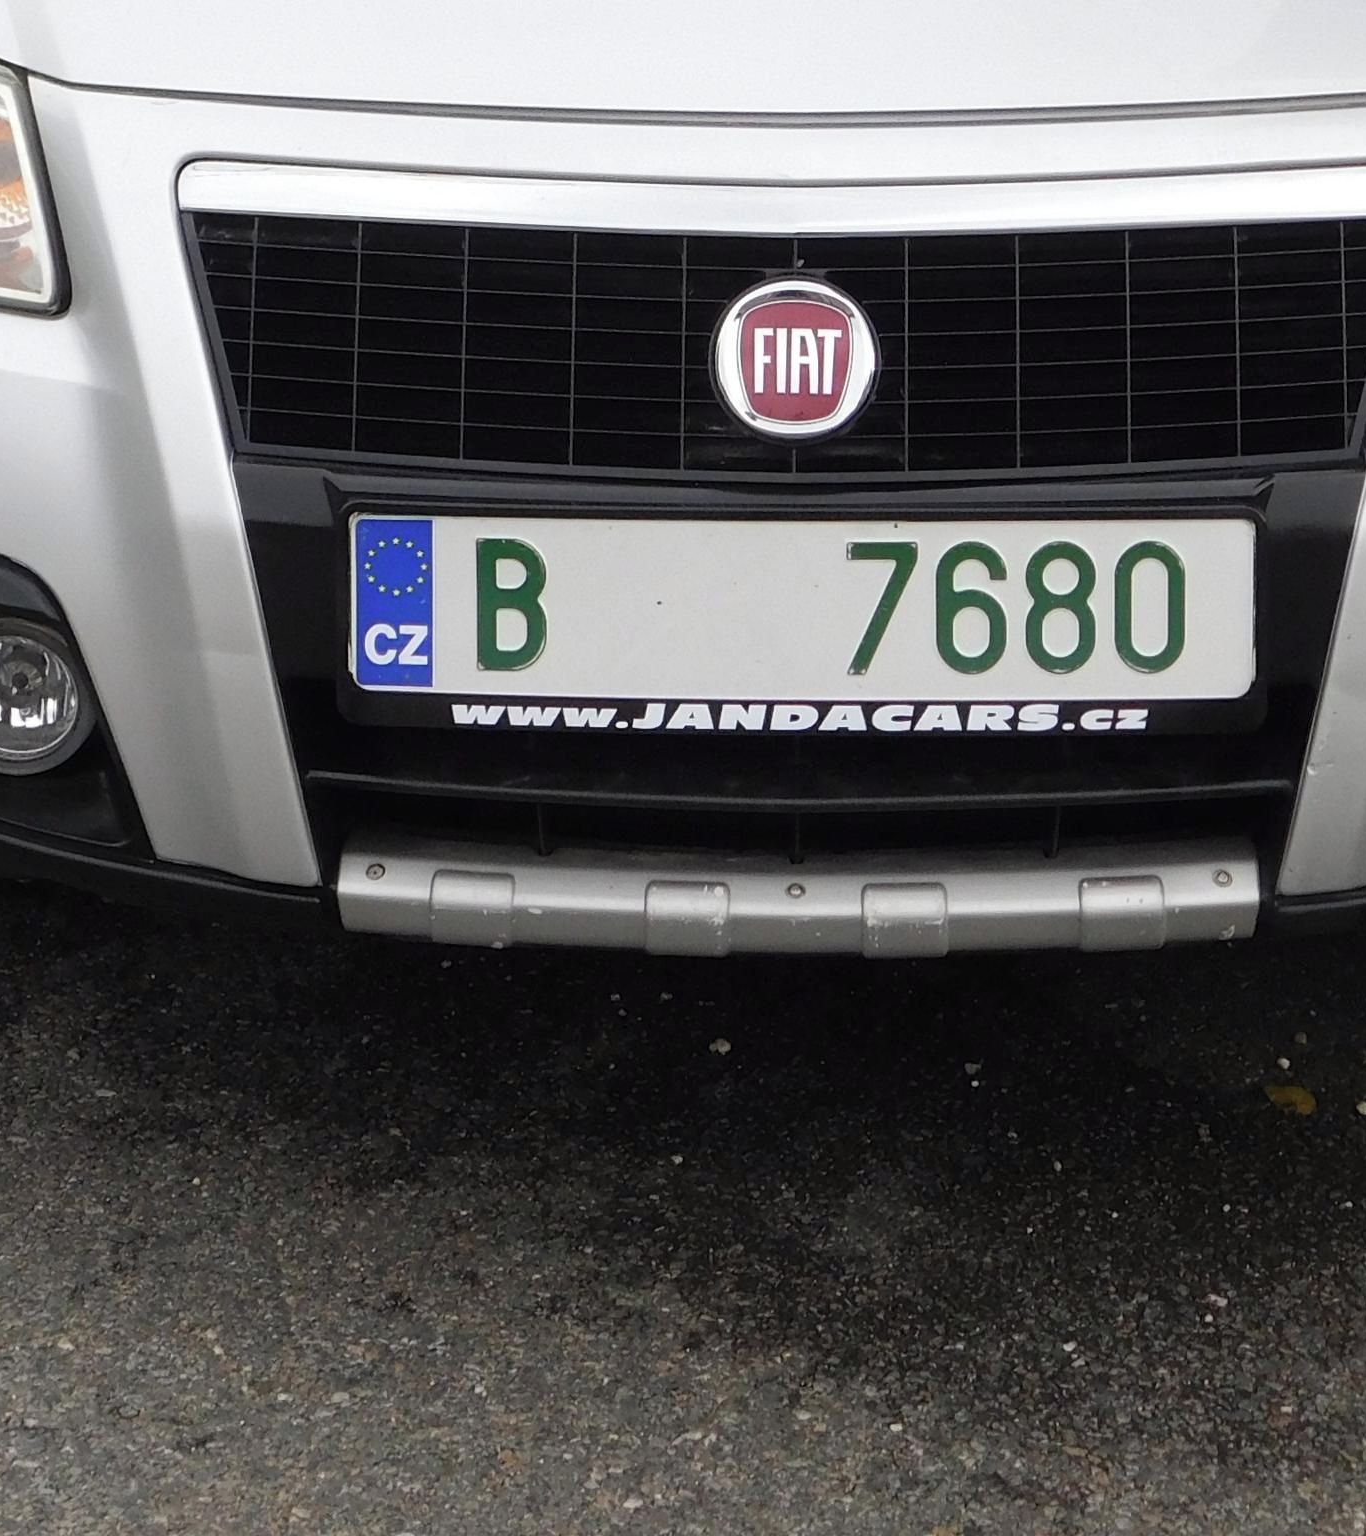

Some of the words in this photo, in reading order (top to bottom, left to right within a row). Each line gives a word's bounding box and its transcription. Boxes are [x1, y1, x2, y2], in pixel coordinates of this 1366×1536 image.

[754, 327, 843, 395] FIAT
[476, 538, 546, 671] B
[846, 540, 1186, 675] 7680
[363, 624, 429, 666] CZ
[450, 704, 1149, 732] www.JANDACARS.cz
